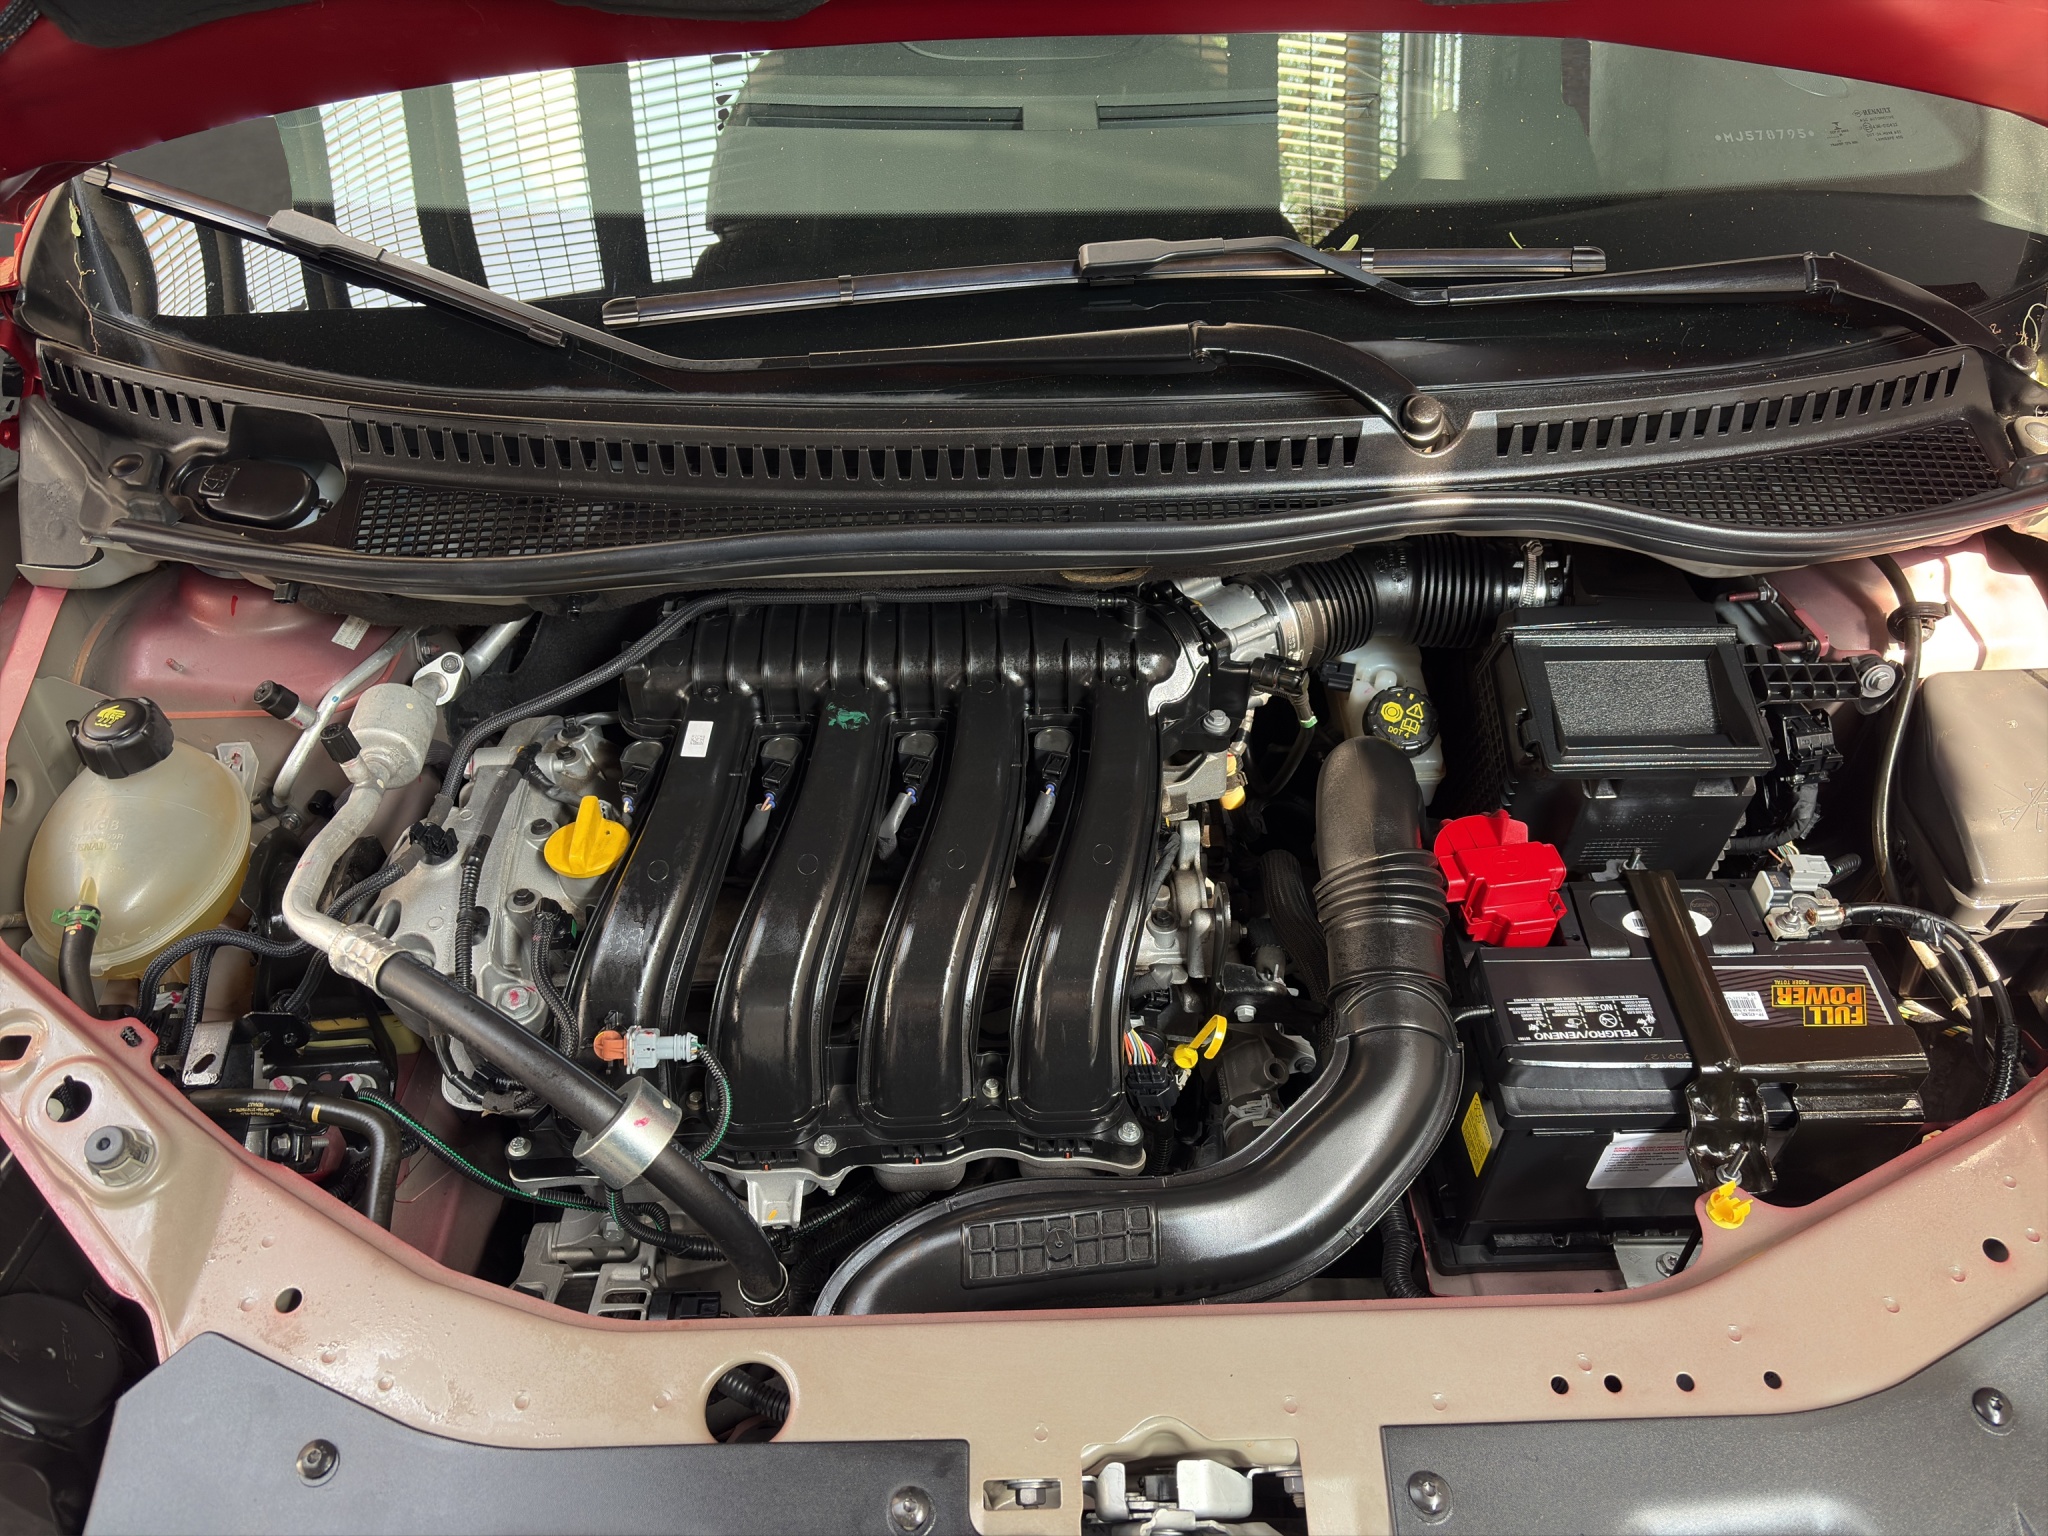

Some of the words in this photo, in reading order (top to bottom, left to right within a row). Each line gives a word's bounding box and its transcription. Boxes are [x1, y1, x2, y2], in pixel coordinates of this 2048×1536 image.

[1862, 107, 1891, 116] RENAULT
[1388, 726, 1404, 736] DOT
[1777, 986, 1863, 1005] POWER
[1600, 1003, 1613, 1012] NO
[1808, 1006, 1863, 1025] FULL
[1533, 1029, 1639, 1041] PELIGRO/VENENO
[670, 1141, 706, 1173] ALAXY
[708, 1172, 725, 1193] SLE
